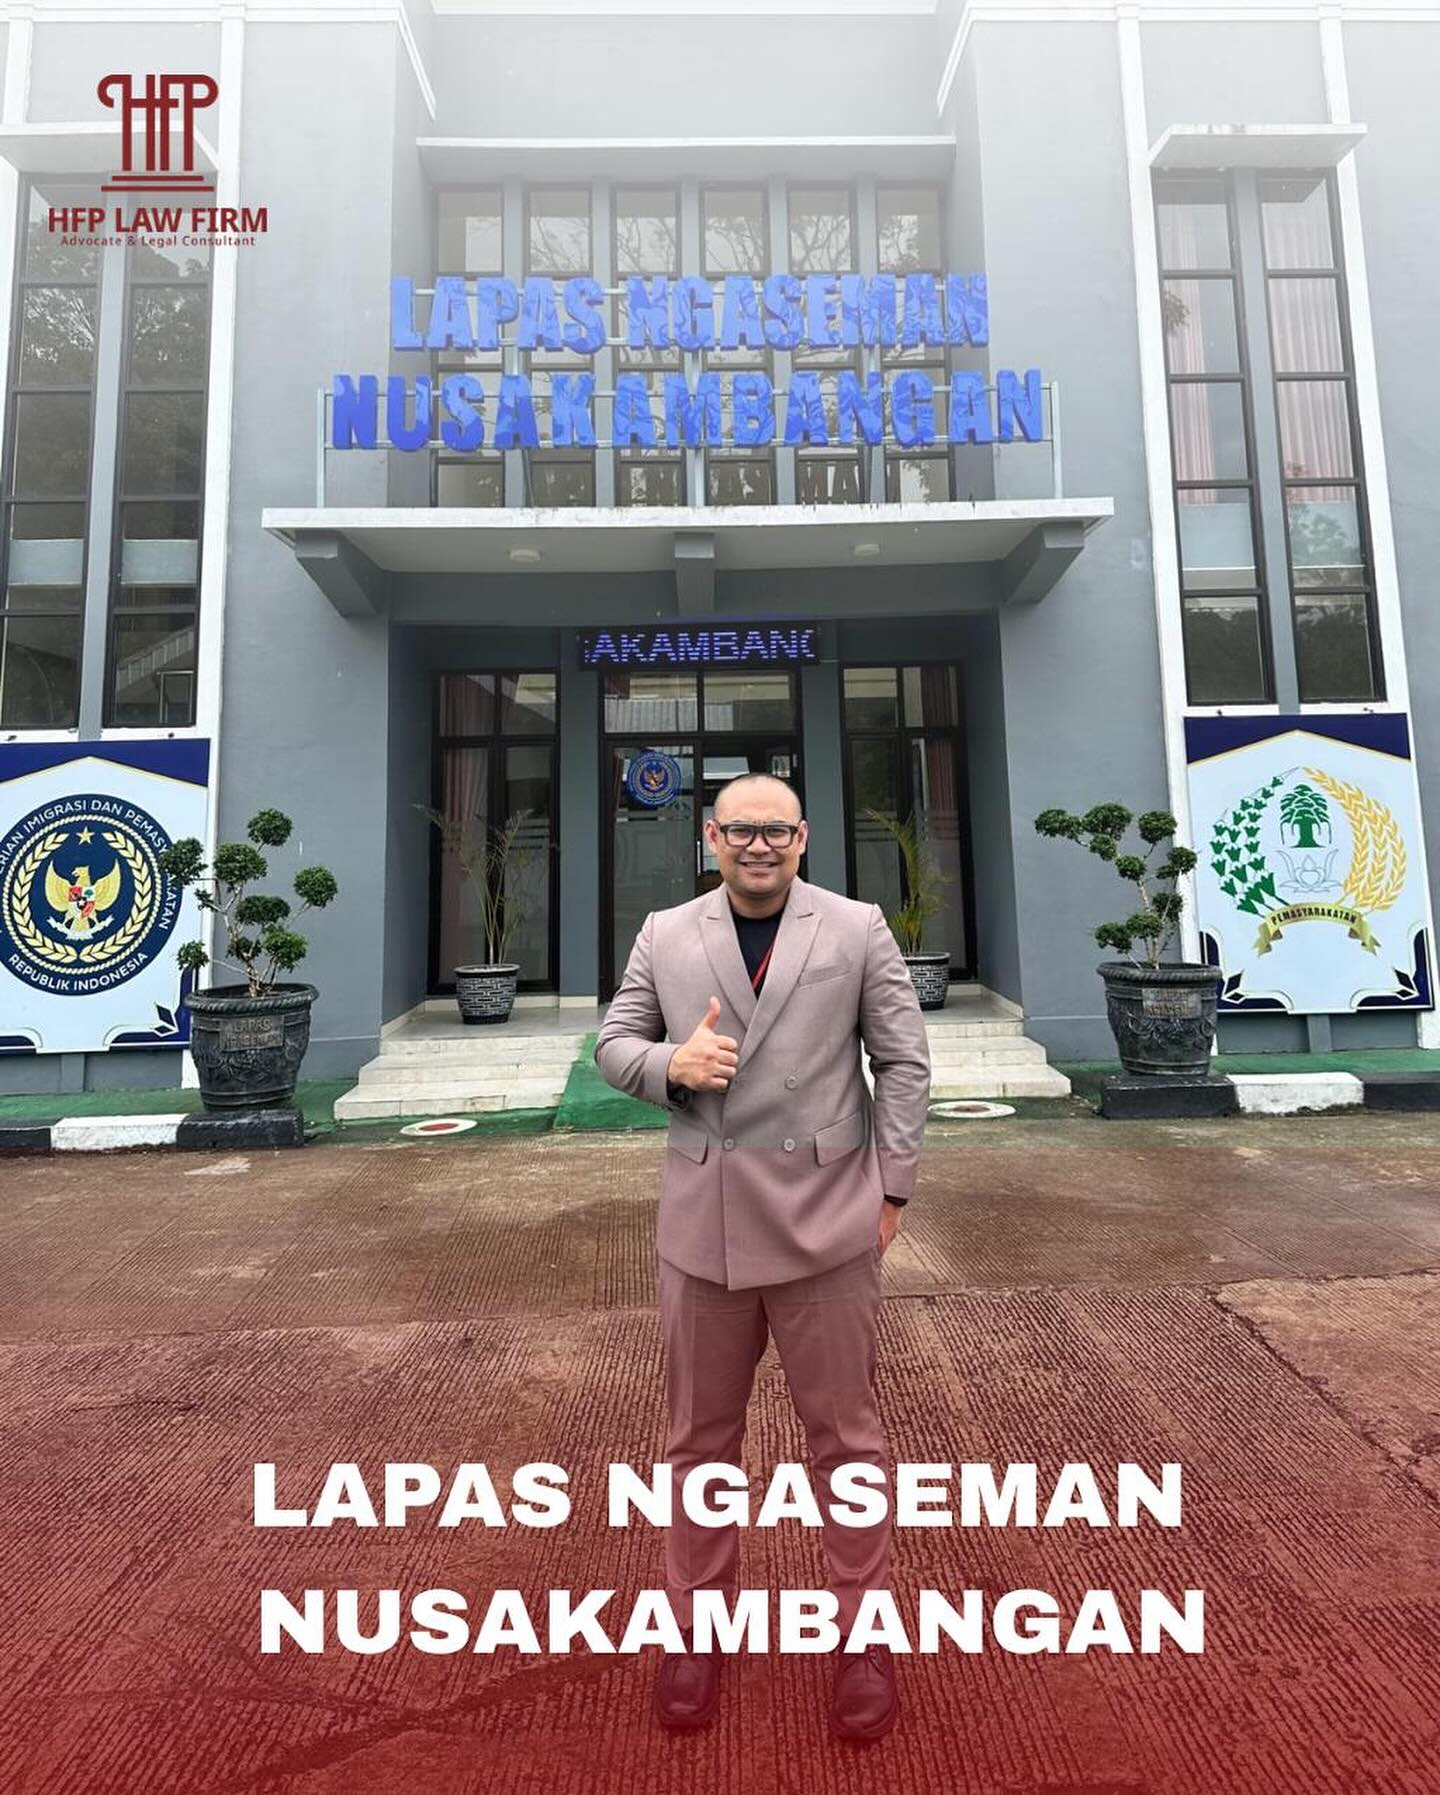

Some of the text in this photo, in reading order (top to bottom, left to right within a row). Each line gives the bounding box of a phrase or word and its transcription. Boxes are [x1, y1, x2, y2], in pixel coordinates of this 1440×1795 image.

[391, 273, 989, 353] LAPAS NGASEMAN
[331, 368, 1044, 451] NUSAKAMBANGAN
[23, 799, 87, 834] IMIGRASI
[91, 799, 123, 817] DAN
[1270, 907, 1357, 925] PEMASYARAKATAN
[9, 951, 149, 991] REPUBLIK INDONESIA
